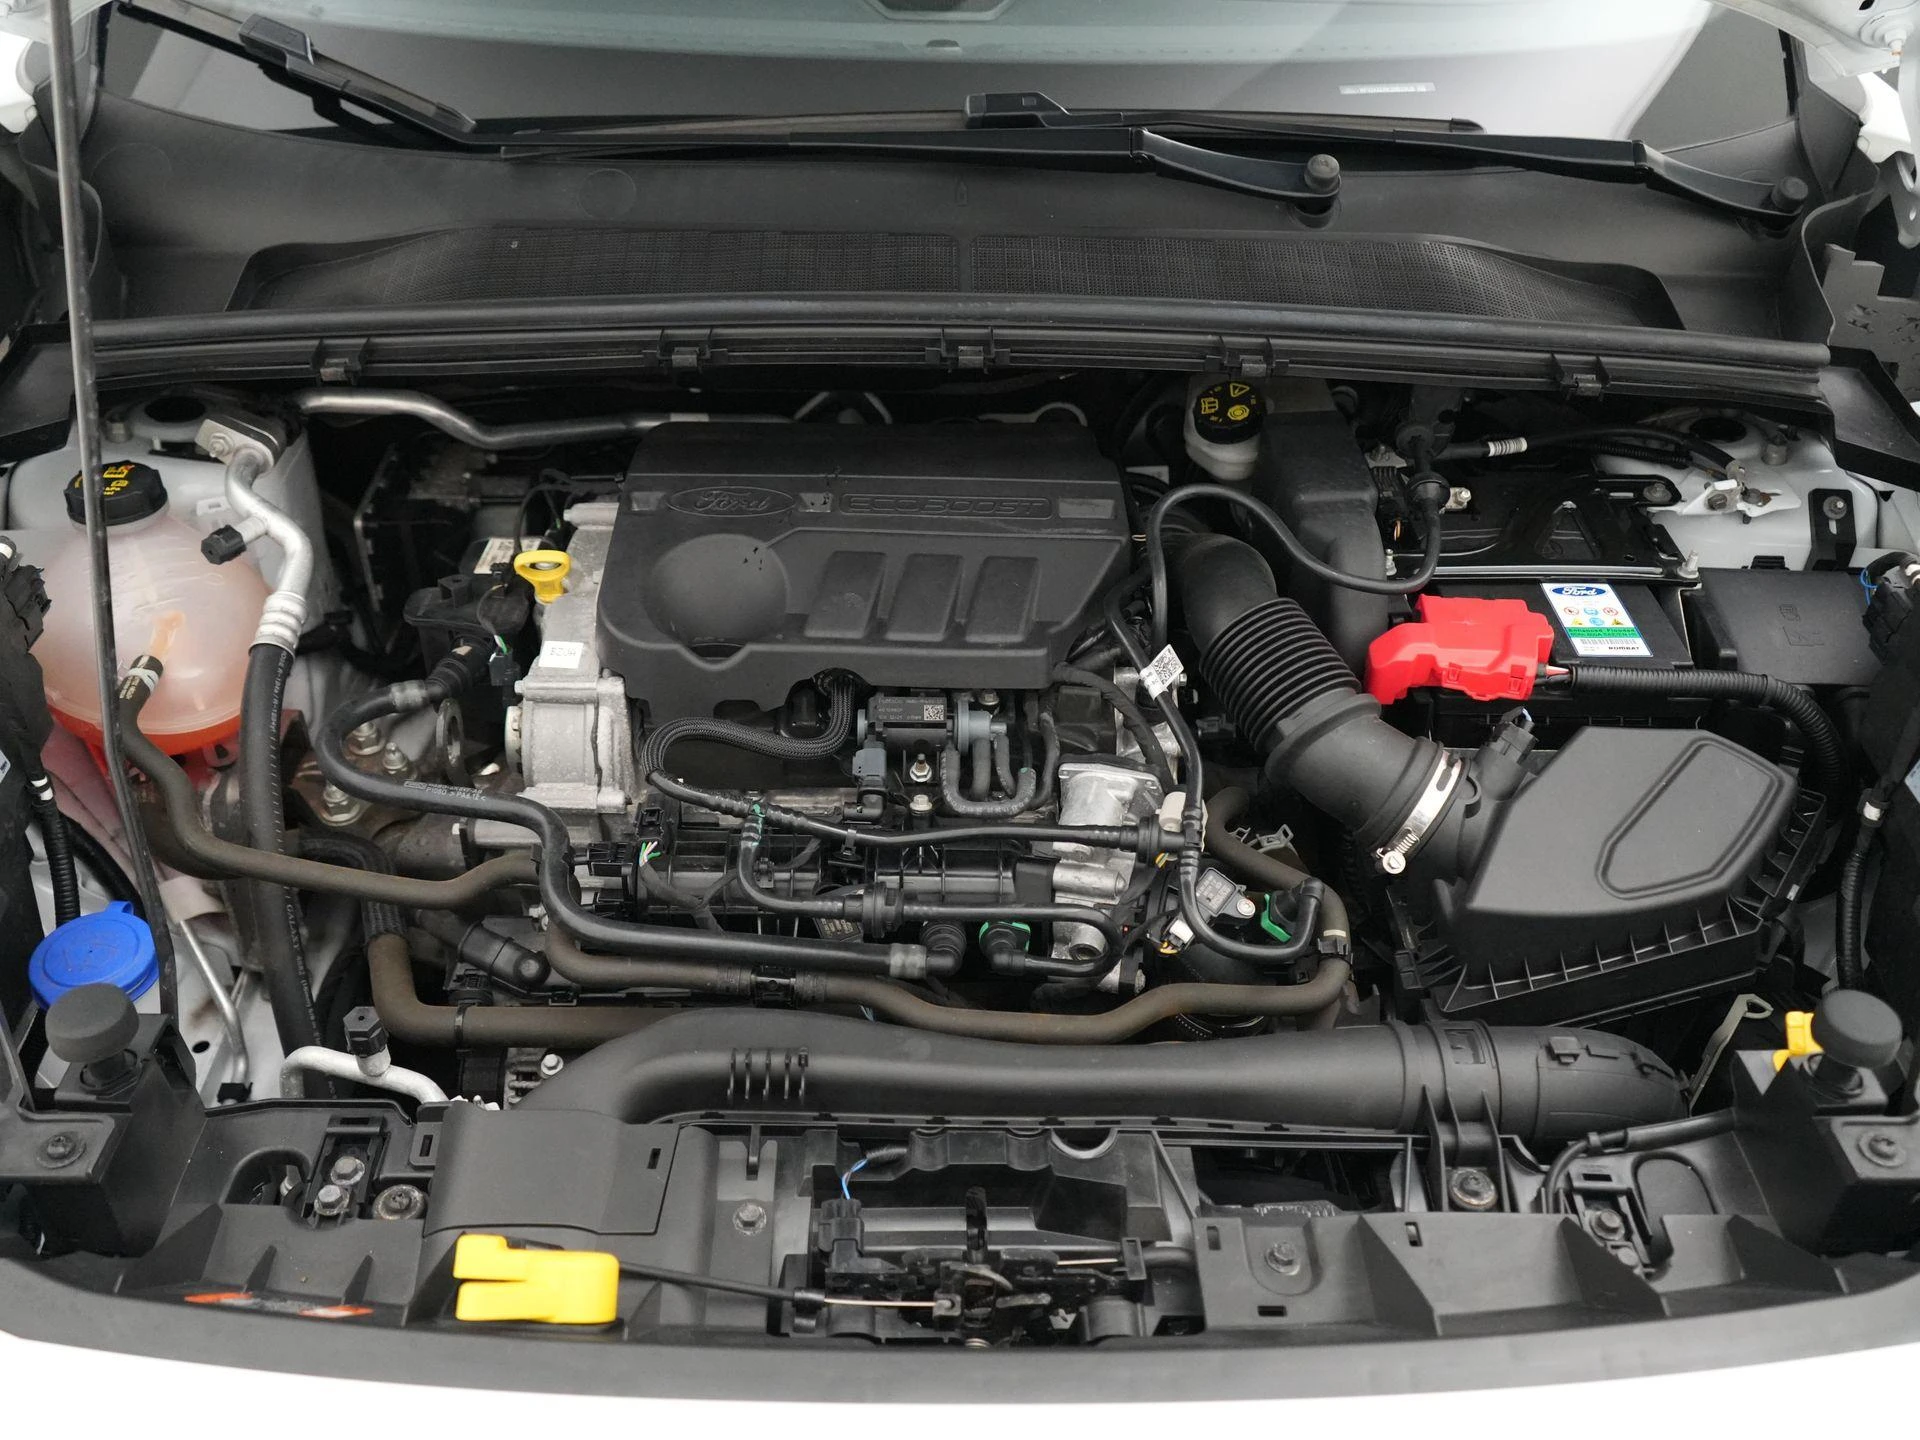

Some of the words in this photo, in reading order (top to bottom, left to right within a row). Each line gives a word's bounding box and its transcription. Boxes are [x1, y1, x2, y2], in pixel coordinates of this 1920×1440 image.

[694, 490, 771, 512] Ford
[850, 498, 1044, 515] ECOBOOST
[1563, 586, 1597, 596] Ford
[287, 904, 301, 949] GALAXY
